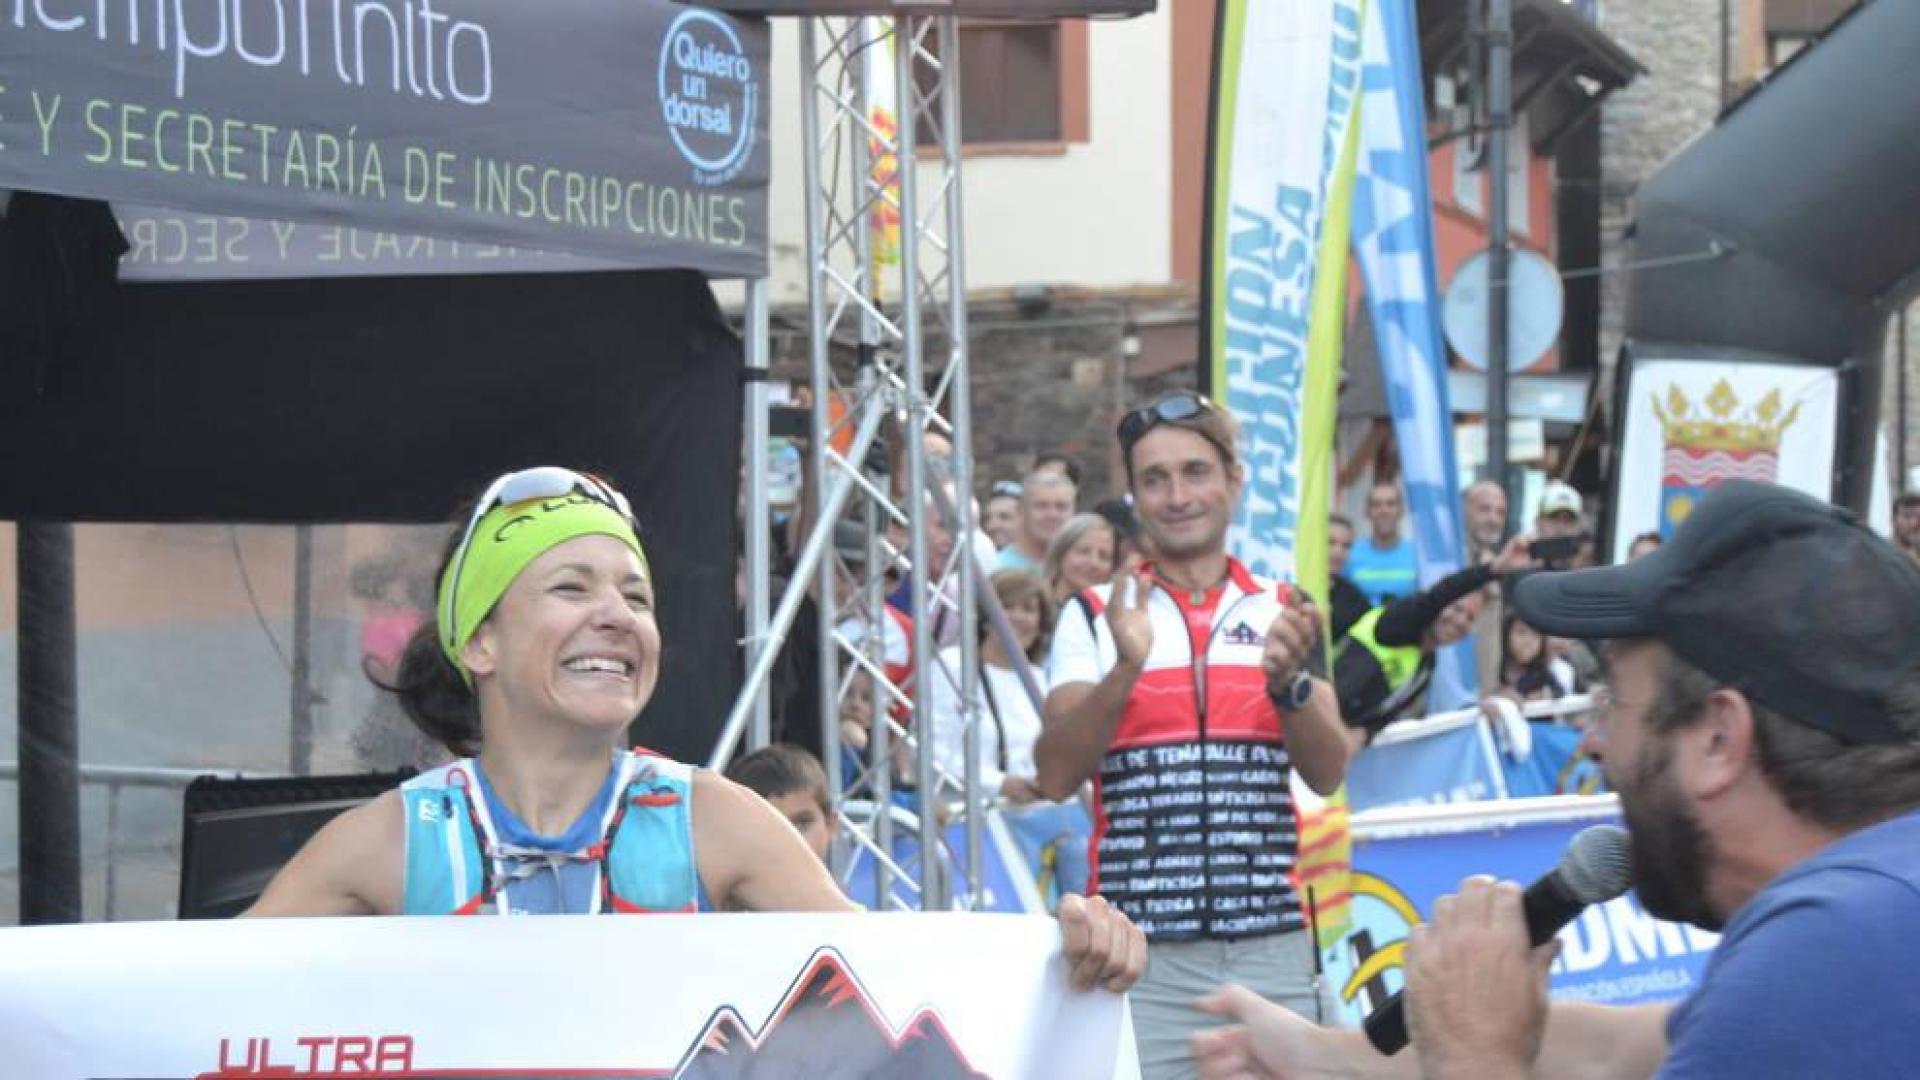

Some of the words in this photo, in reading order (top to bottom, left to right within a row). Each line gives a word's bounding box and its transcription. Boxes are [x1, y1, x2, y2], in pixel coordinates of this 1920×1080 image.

[674, 31, 750, 82] Quiero
[682, 74, 706, 100] un
[663, 93, 731, 135] dorsal
[32, 89, 61, 156] Y
[84, 99, 386, 199] SECRETARÍA
[404, 147, 457, 208] DE
[473, 155, 746, 247] INSCRIPCIONES
[219, 1035, 415, 1073] ULTRA
